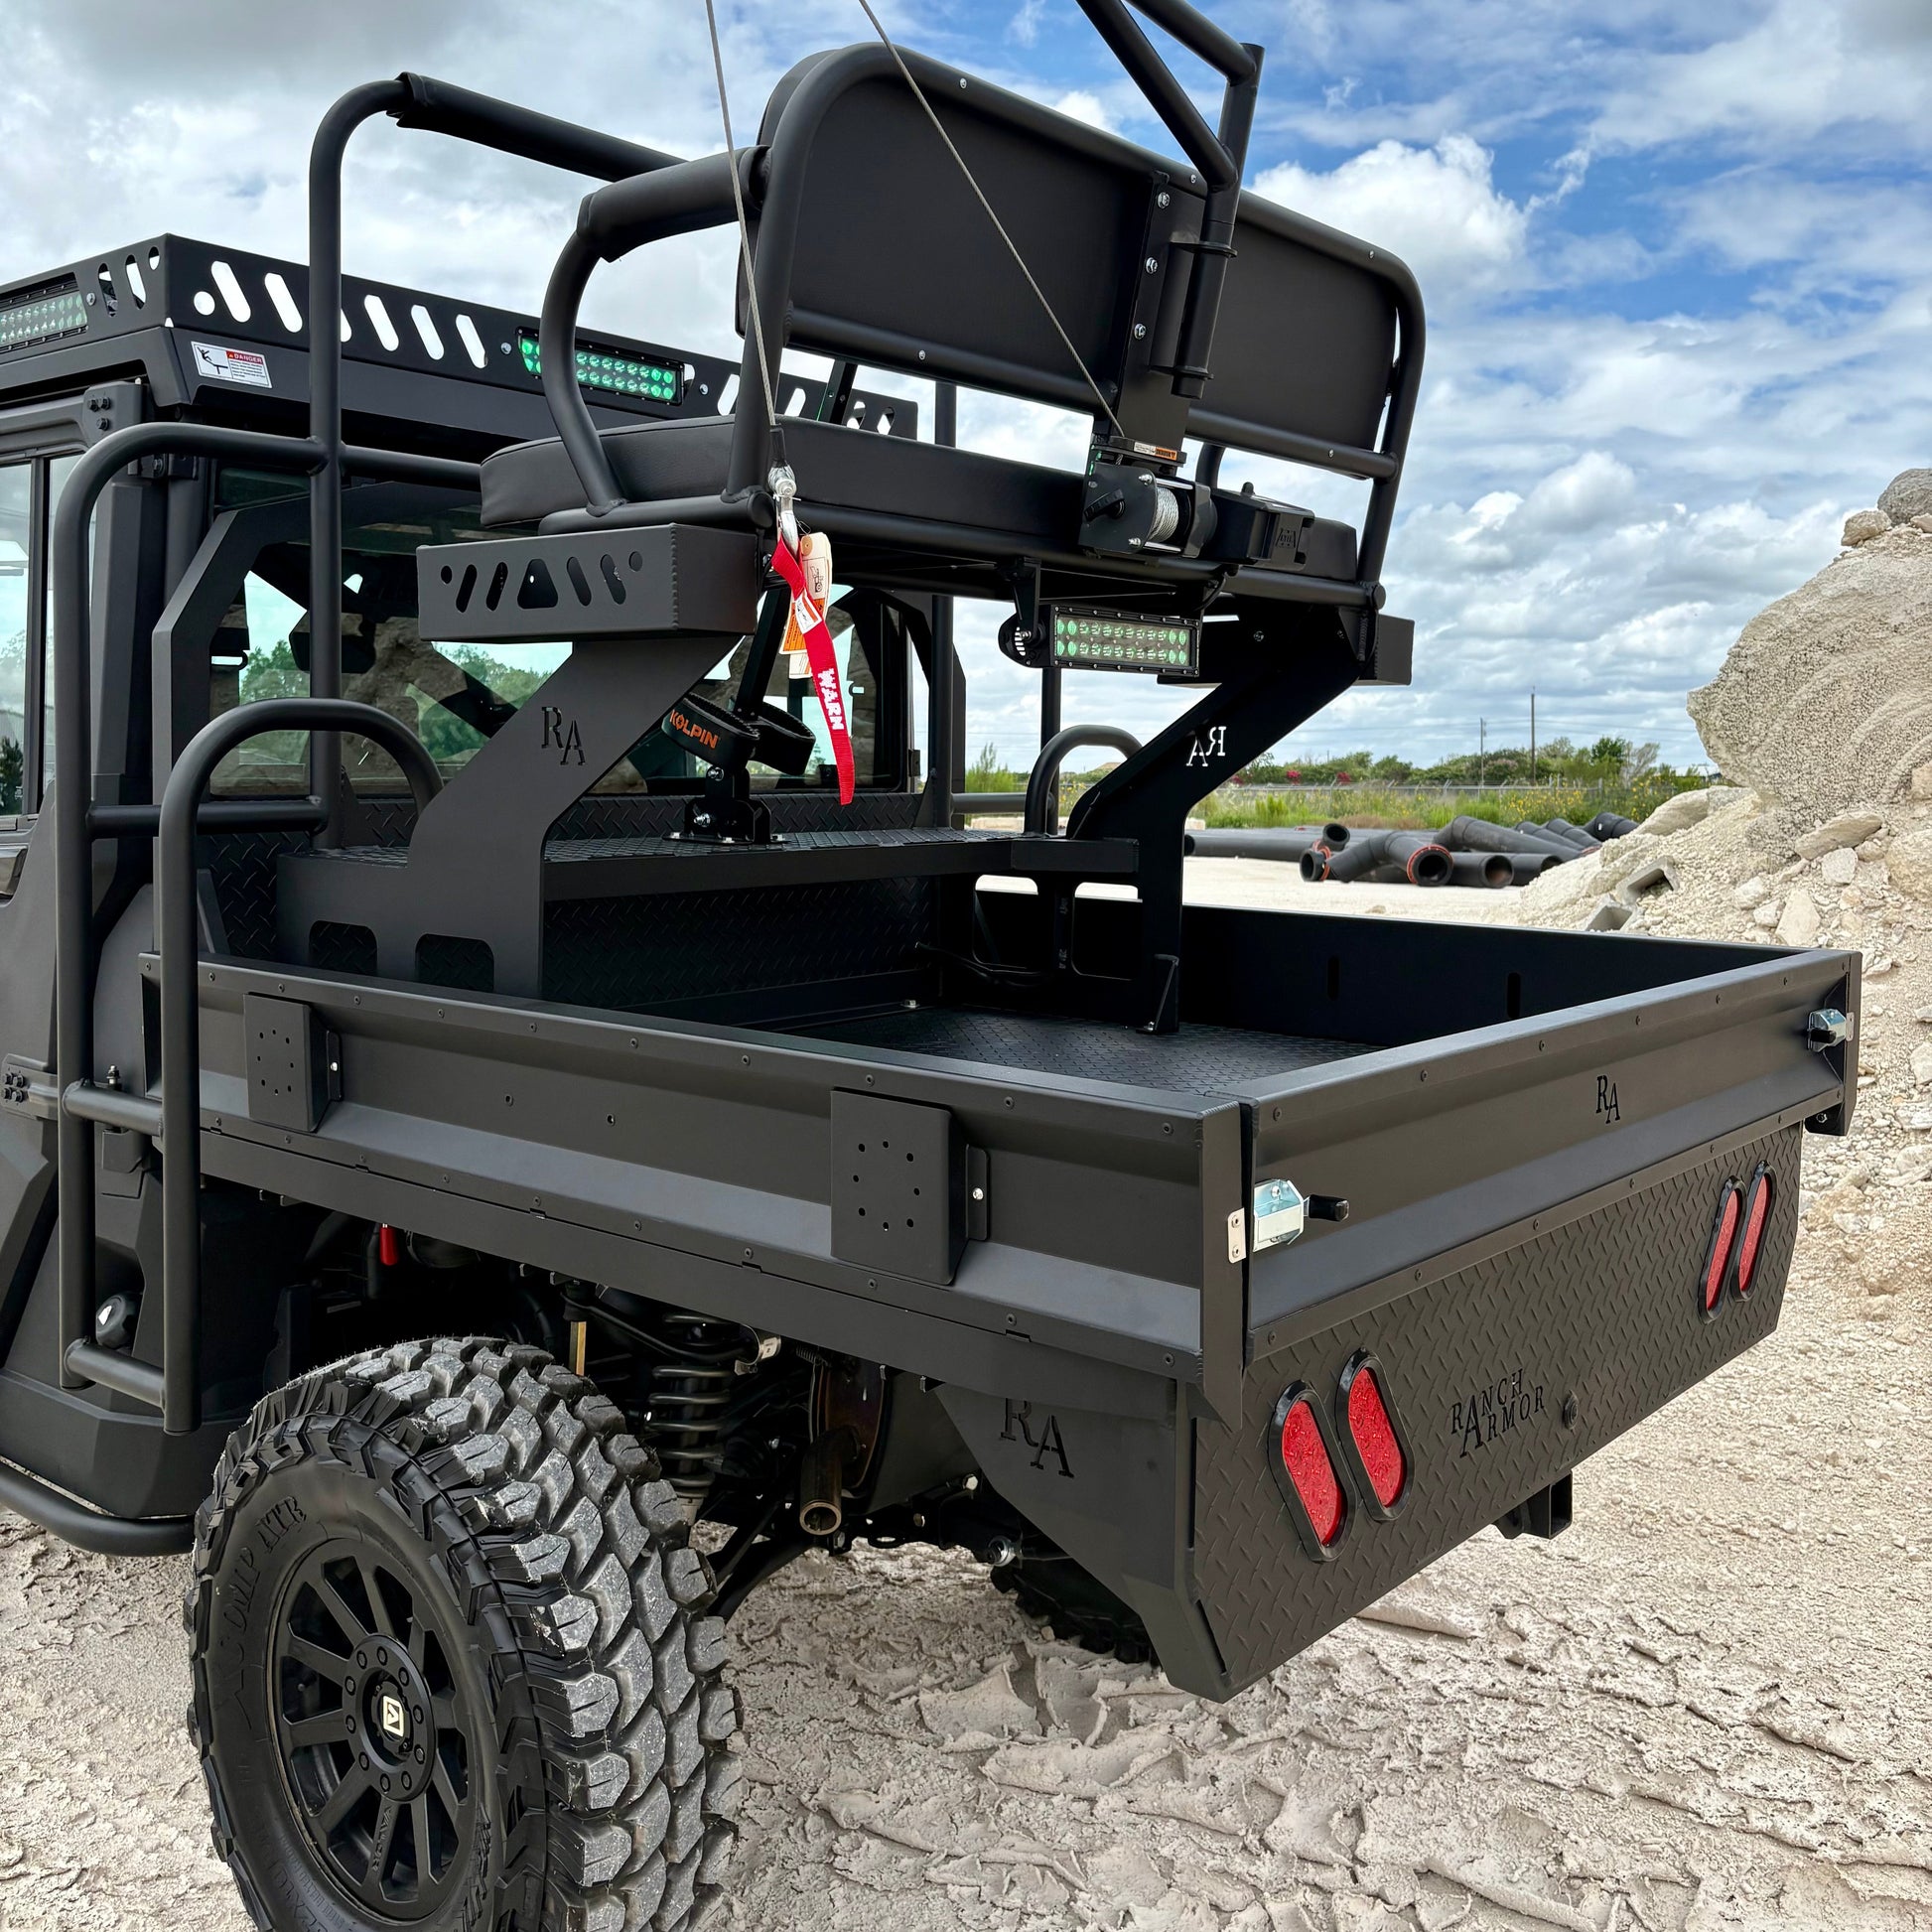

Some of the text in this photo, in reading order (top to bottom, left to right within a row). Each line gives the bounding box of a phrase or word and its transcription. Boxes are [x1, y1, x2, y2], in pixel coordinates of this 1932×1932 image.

[234, 352, 262, 363] DANGER
[669, 709, 719, 750] KOLPIN
[818, 668, 845, 730] WARN
[541, 706, 586, 766] RA
[1595, 1075, 1621, 1124] RA
[1000, 1398, 1075, 1478] RA
[1450, 1368, 1524, 1457] RANCH
[1459, 1386, 1545, 1458] ARMOR
